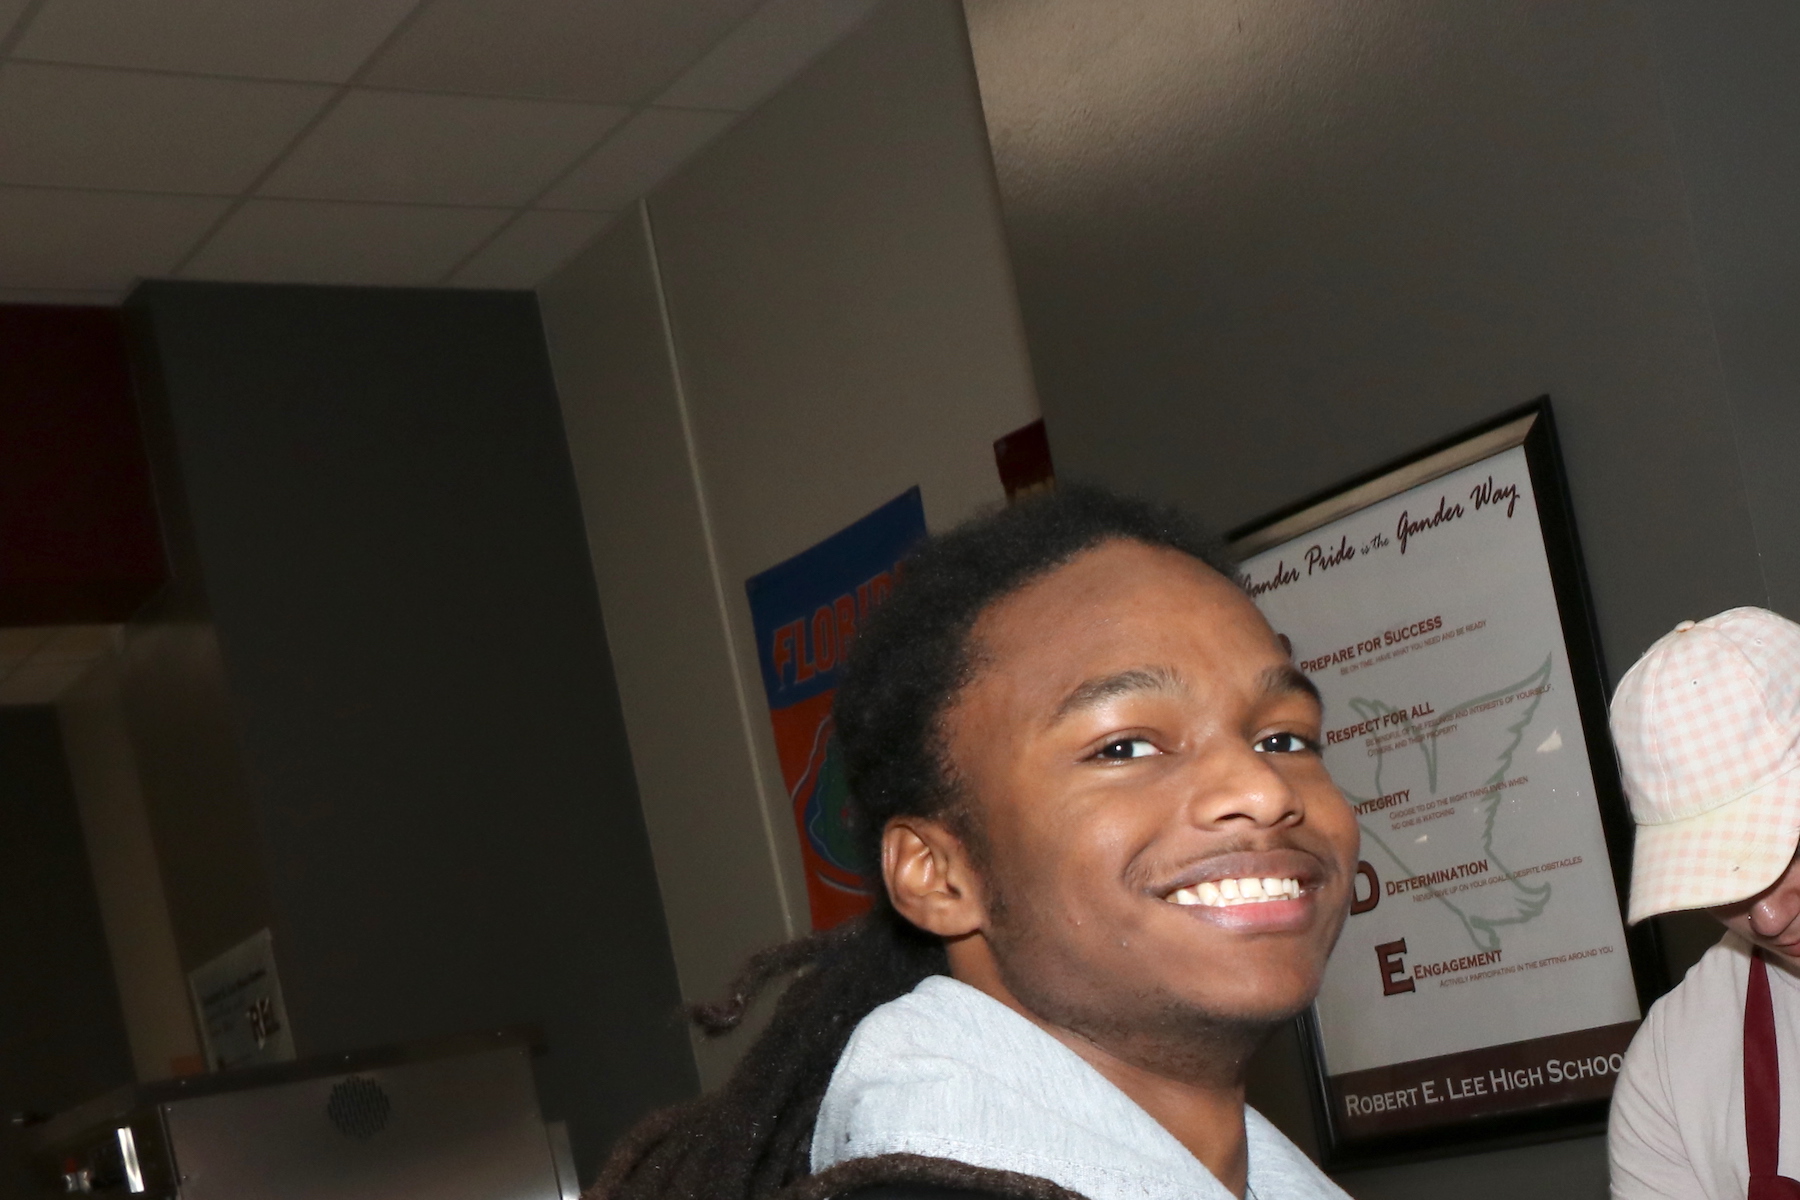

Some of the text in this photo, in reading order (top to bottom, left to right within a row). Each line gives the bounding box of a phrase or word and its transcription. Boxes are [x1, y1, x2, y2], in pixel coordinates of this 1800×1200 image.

[1304, 535, 1356, 576] Pride
[1360, 542, 1370, 556] is
[1370, 532, 1390, 552] the
[1396, 496, 1465, 555] Gander
[1469, 475, 1521, 518] Way
[1300, 615, 1443, 673] PREPARE FOR SUCCESS
[1376, 653, 1392, 665] HAVE
[1392, 647, 1410, 659] WHAT
[1411, 642, 1425, 654] YOU
[1424, 636, 1441, 648] NEED
[1441, 630, 1456, 642] AND
[1456, 626, 1465, 637] BE
[1465, 619, 1487, 634] READY
[1326, 701, 1435, 747] RESPECT FOR ALL
[1455, 709, 1469, 720] AND
[1469, 700, 1504, 715] INTERESTS
[1505, 694, 1516, 704] OF
[1426, 723, 1459, 740] PROPERTY
[1354, 789, 1410, 816] NTEGRITY
[1389, 806, 1417, 820] CHOOSE
[1417, 804, 1426, 813] TO
[1426, 802, 1436, 812] DO
[1437, 798, 1449, 808] THE
[1449, 792, 1469, 806] RIGHT
[1508, 775, 1529, 789] WHEN
[1401, 818, 1415, 828] ONE
[1422, 807, 1456, 823] WATCHING
[1385, 859, 1489, 897] DETERMINATION
[1413, 890, 1433, 903] NEVER
[1451, 885, 1459, 895] UP
[1459, 883, 1470, 892] ON
[1470, 878, 1488, 890] YOUR
[1513, 866, 1541, 880] DESPITE
[1541, 856, 1584, 873] OBSTACLES
[1374, 937, 1503, 997] E ENGAGEMENT
[1440, 945, 1614, 988] ACTIVELY PARTICIPATING IN THE SETTING AROUND YOU
[1345, 1053, 1626, 1118] ROBERT E. LEE HIGH SCHOO
